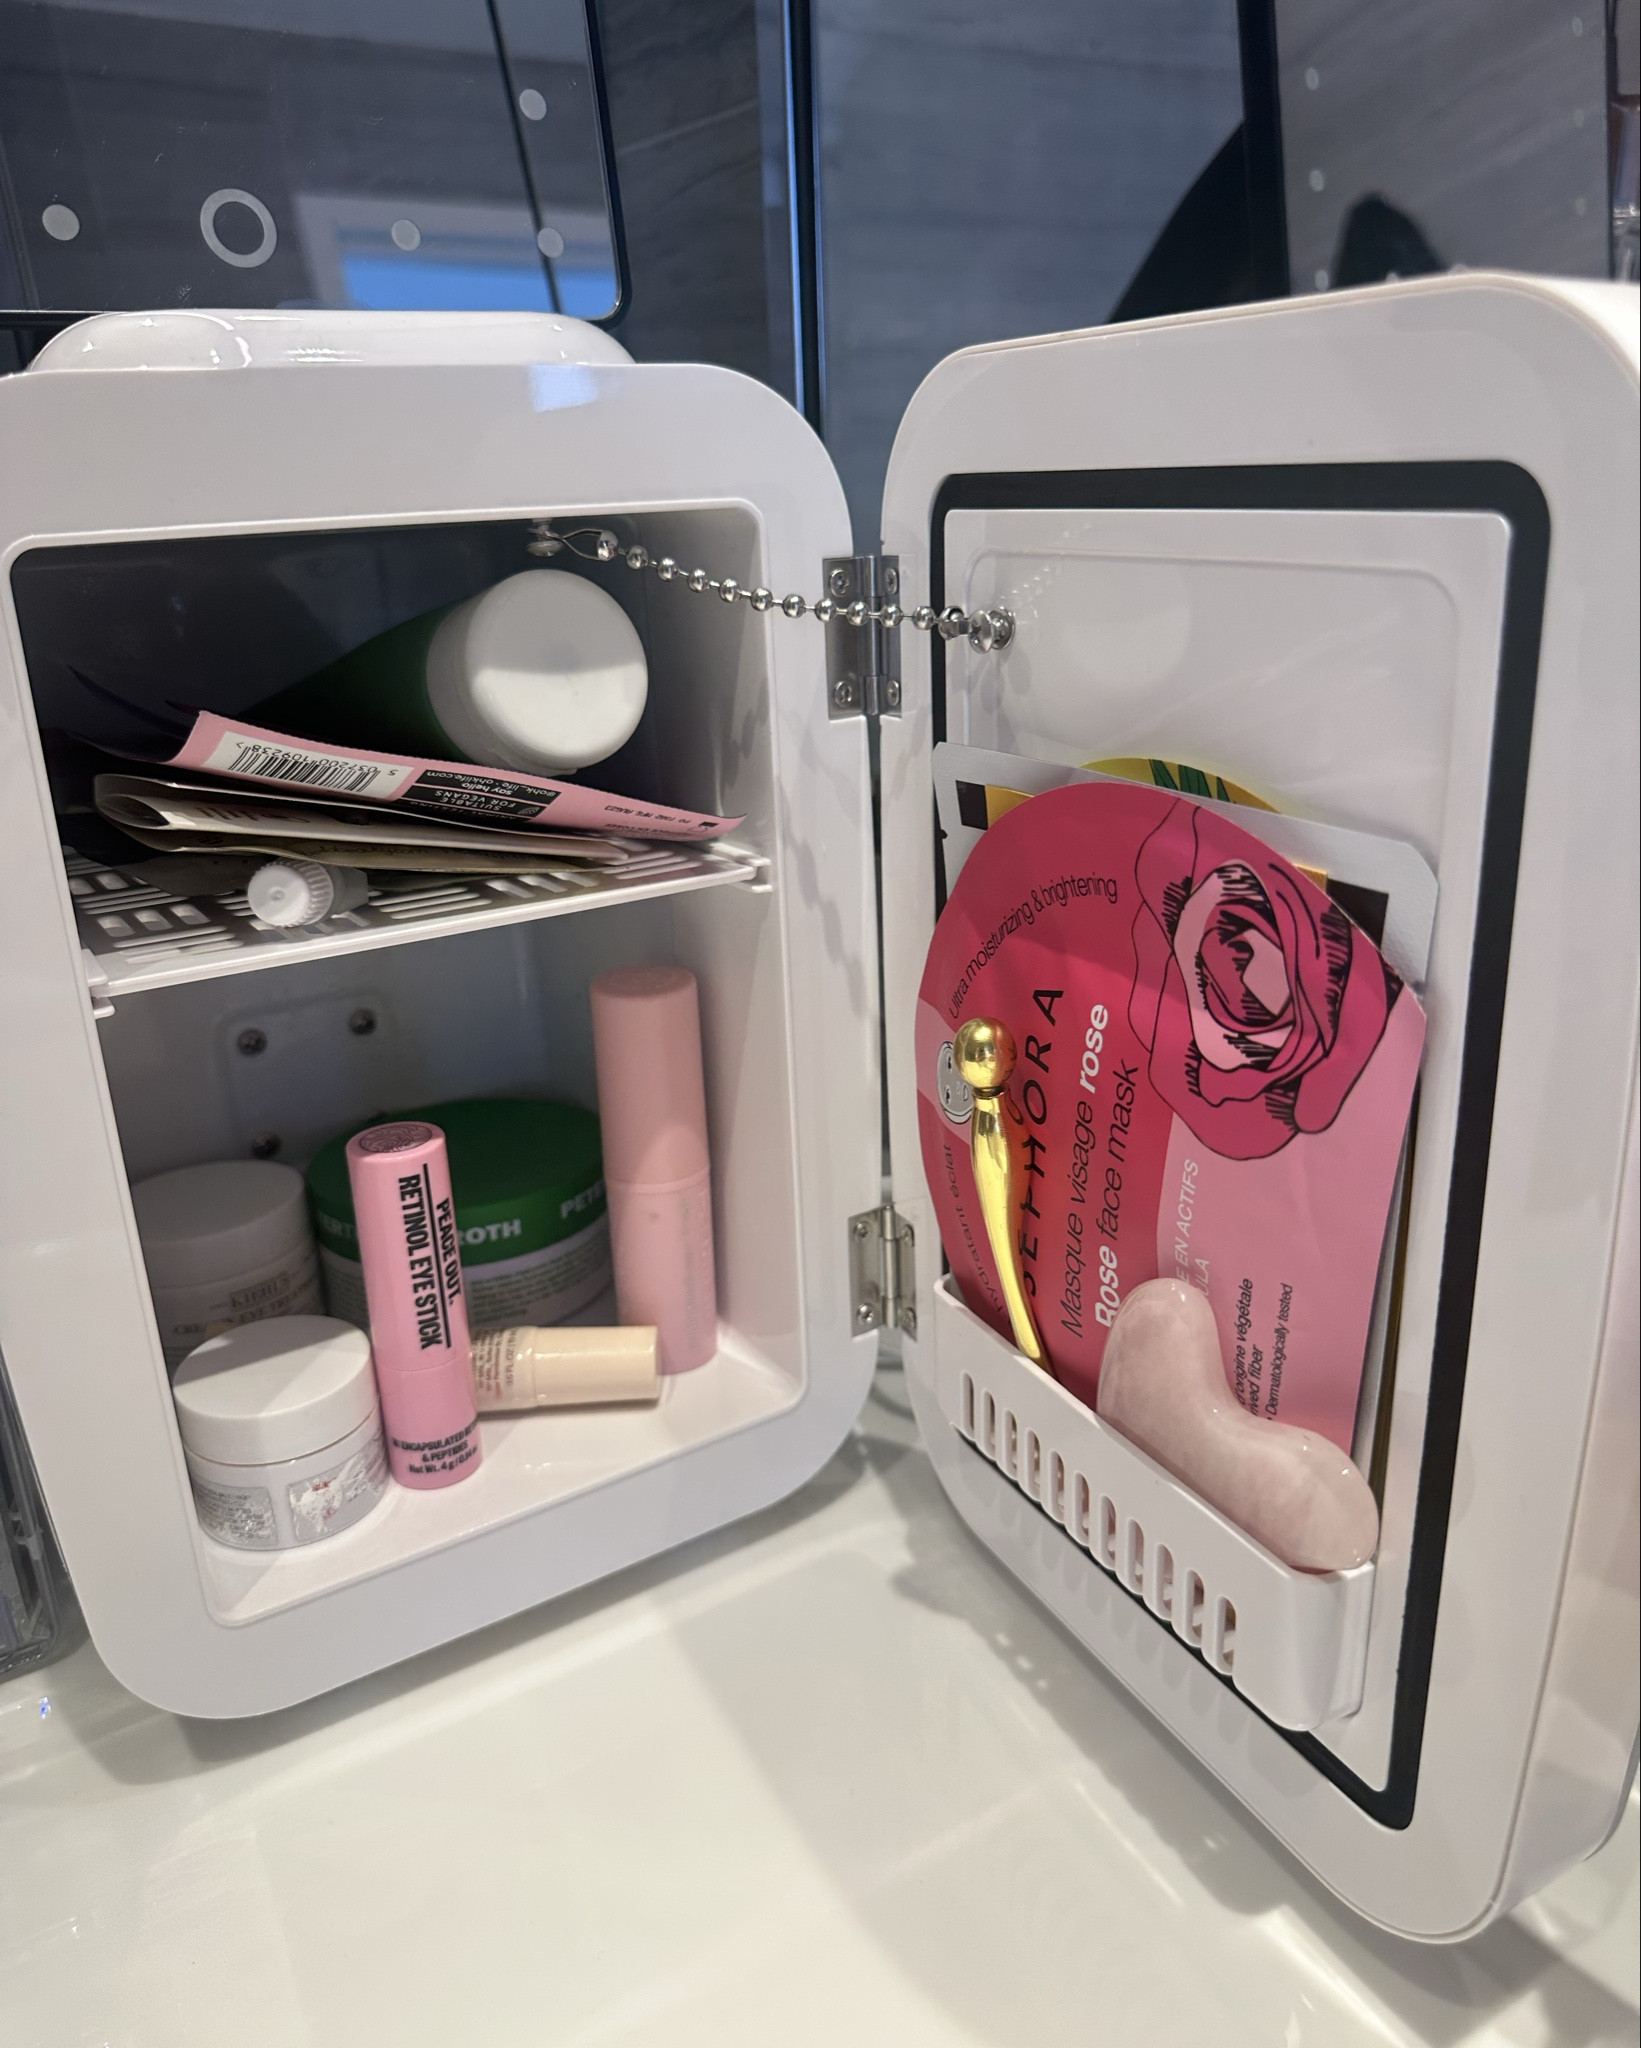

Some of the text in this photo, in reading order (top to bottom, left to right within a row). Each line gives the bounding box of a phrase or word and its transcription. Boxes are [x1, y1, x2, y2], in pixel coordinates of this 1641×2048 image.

[251, 744, 399, 776] 5 037200 109238
[426, 771, 494, 786] ohklife.com
[461, 782, 514, 796] say hello
[434, 789, 517, 808] FOR VEGANS
[439, 795, 502, 811] SUITABLE
[948, 872, 1118, 1019] Ultra moisturizing & brightening
[1060, 1004, 1108, 1339] Masque visage rose
[1095, 1059, 1139, 1328] Rose face mask
[1175, 1159, 1199, 1237] ACTIFS
[398, 1174, 443, 1350] RETINOL EYE STICK
[437, 1198, 456, 1262] PEACE
[956, 1206, 1003, 1313] hydratant
[1174, 1237, 1190, 1267] EN
[1234, 1278, 1253, 1342] végétale
[1247, 1344, 1263, 1380] fiber
[1265, 1282, 1293, 1416] Dermatologically tested
[431, 1440, 469, 1461] PEPTIDES
